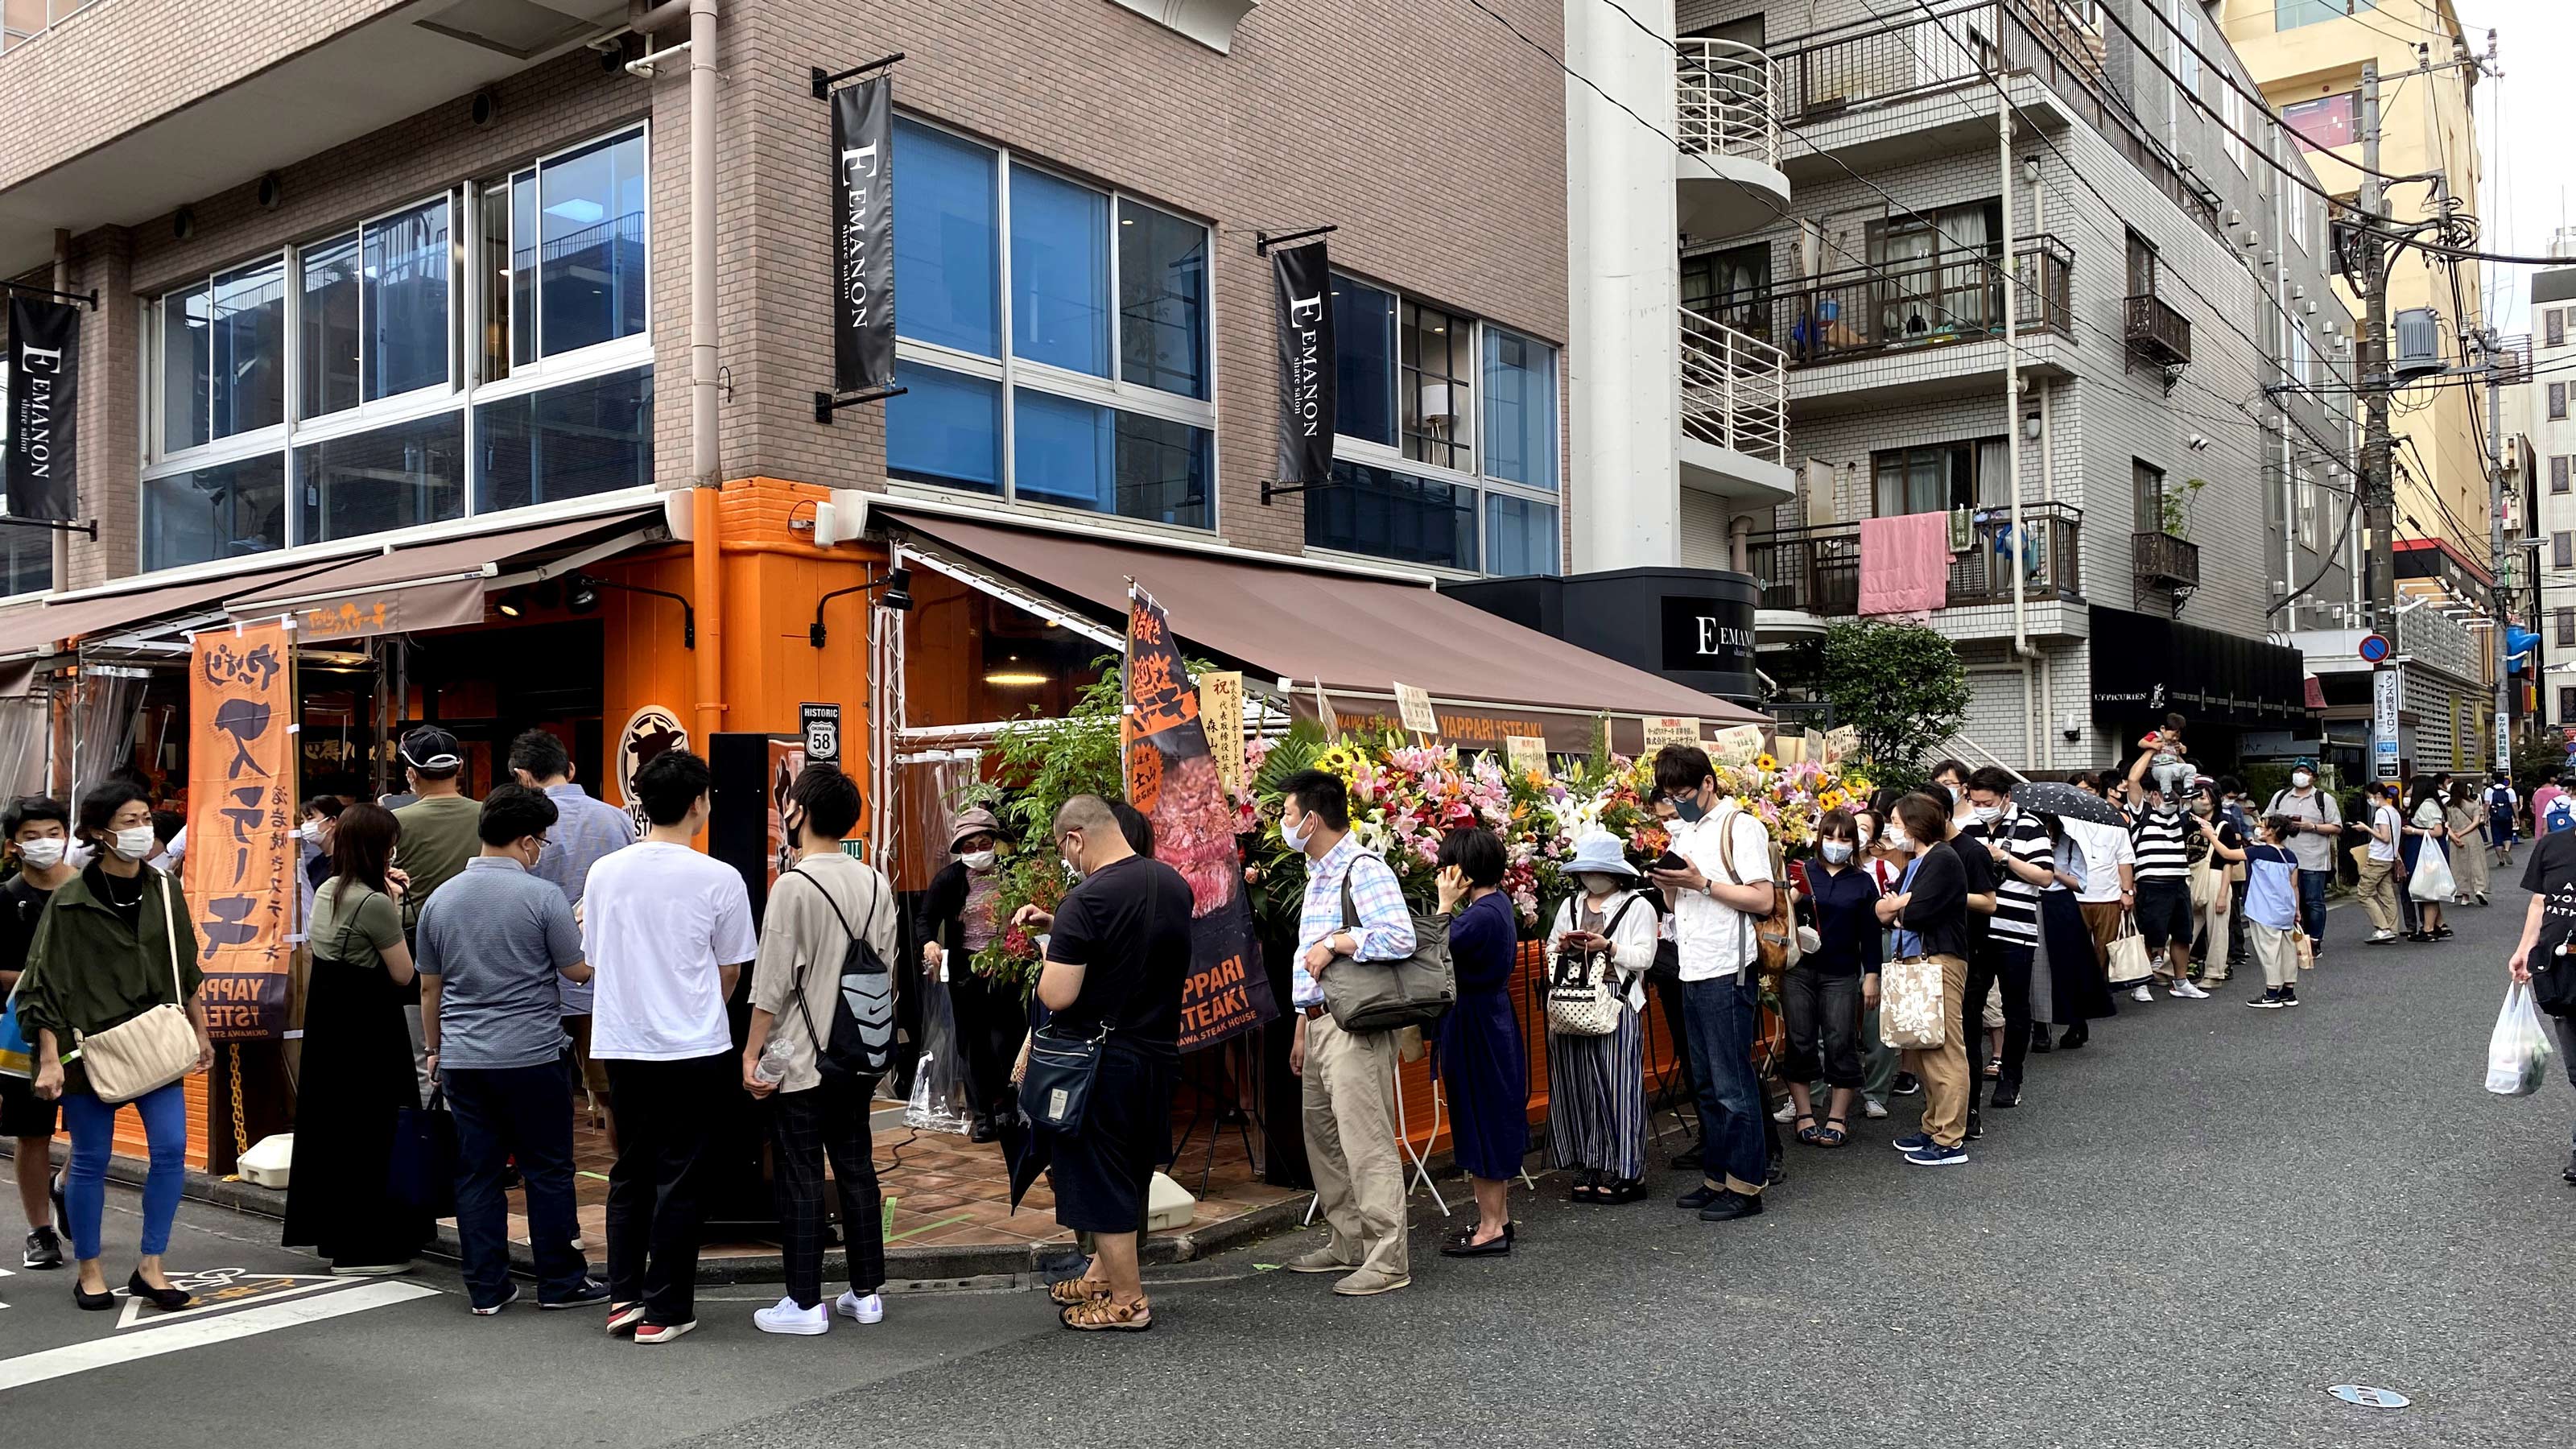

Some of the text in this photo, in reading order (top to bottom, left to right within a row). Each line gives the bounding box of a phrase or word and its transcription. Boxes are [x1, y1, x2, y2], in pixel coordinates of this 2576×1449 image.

[841, 138, 877, 328] E EMANON
[842, 265, 850, 299] salon
[1290, 291, 1322, 437] E EMANON
[1294, 357, 1302, 386] share
[21, 398, 31, 453] share salon
[22, 341, 61, 478] E EMANON
[1695, 616, 1719, 654] E
[1213, 679, 1230, 696] 祝
[2385, 674, 2396, 733] メンズ脱毛サロン
[804, 708, 838, 718] HISTORIC
[1439, 715, 1495, 740] YAPPARI
[813, 733, 831, 749] 58
[2551, 894, 2576, 903] YO
[1200, 1022, 1228, 1040] STEAK
[1228, 1010, 1257, 1028] HOUSE
